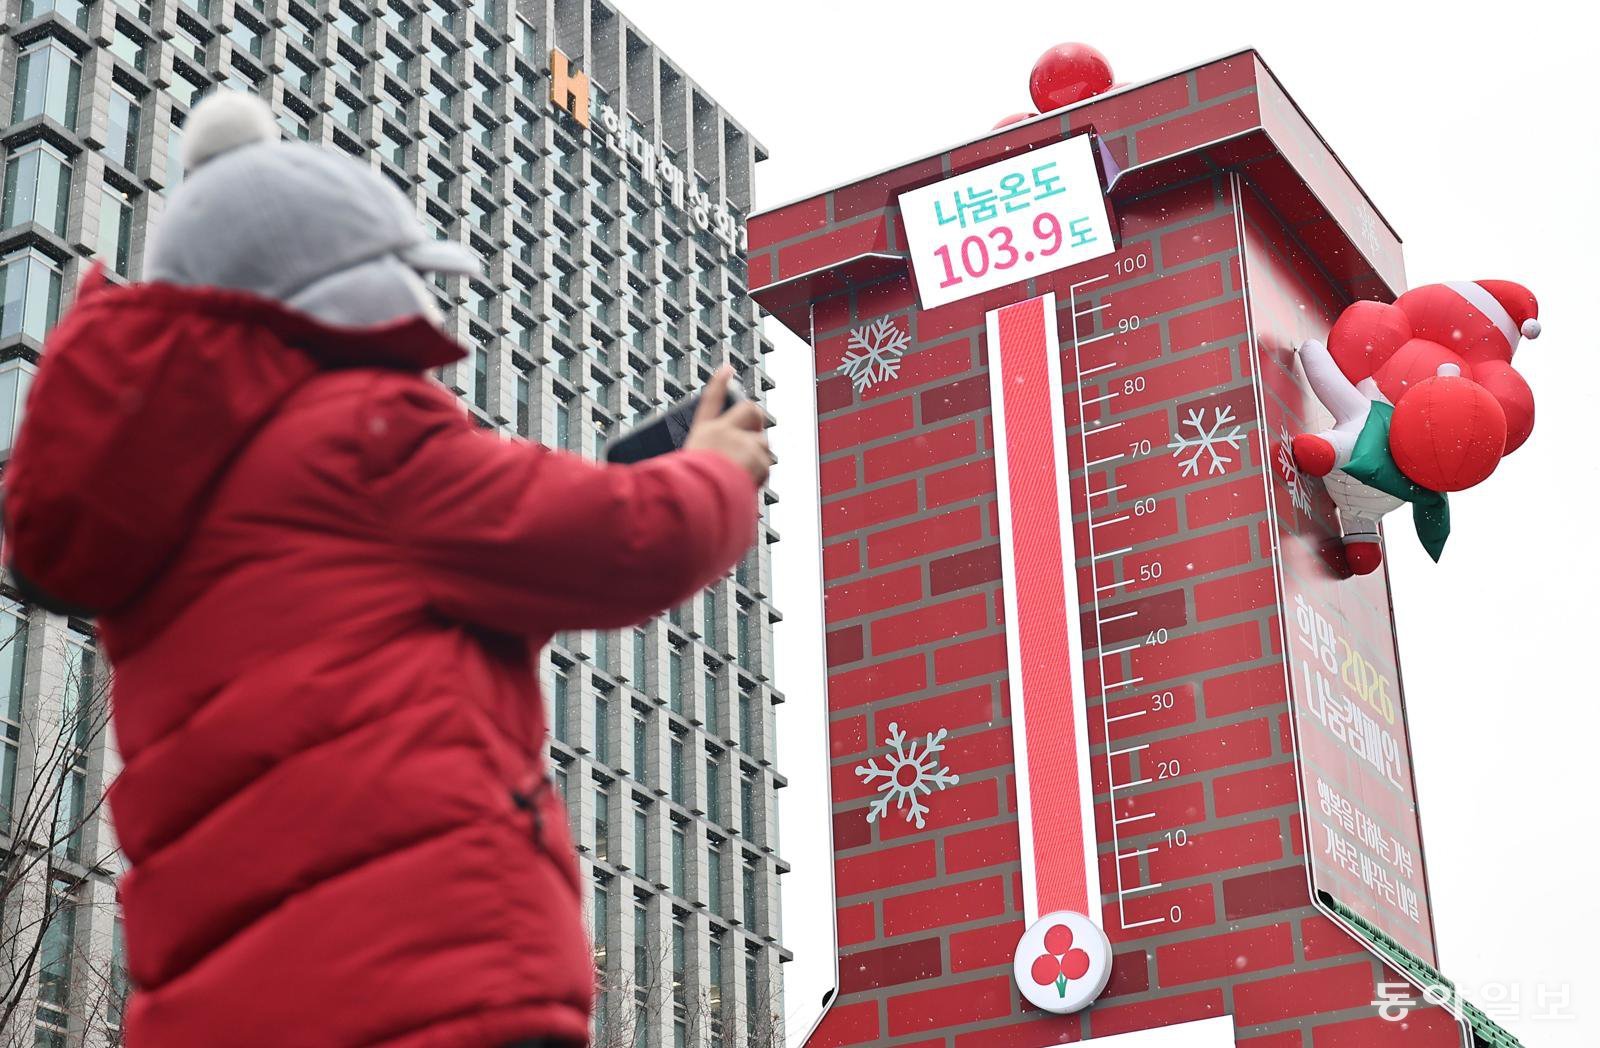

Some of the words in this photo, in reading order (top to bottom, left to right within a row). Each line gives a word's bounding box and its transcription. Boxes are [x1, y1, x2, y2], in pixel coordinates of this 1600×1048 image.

[933, 161, 1067, 229] 나눔온도
[1114, 253, 1148, 276] 100
[1118, 315, 1141, 334] 90
[1123, 376, 1146, 395] 80
[1129, 439, 1151, 459] 70
[1134, 497, 1157, 517] 60
[1140, 562, 1163, 581] 50
[1145, 628, 1169, 647] 40
[1294, 593, 1338, 675] 희망
[1338, 635, 1395, 725] 2026
[1151, 691, 1175, 711] 30
[1303, 659, 1404, 792] 나눔캠페인
[1157, 759, 1181, 780] 20
[1317, 777, 1355, 836] 행복을
[1355, 808, 1391, 863] 더하는
[1390, 836, 1414, 880] 기부
[1164, 829, 1187, 849] 10
[1323, 823, 1360, 878] 기부로
[1360, 852, 1396, 906] 바꾸는
[1395, 879, 1420, 924] 내일
[1169, 905, 1182, 923] 0
